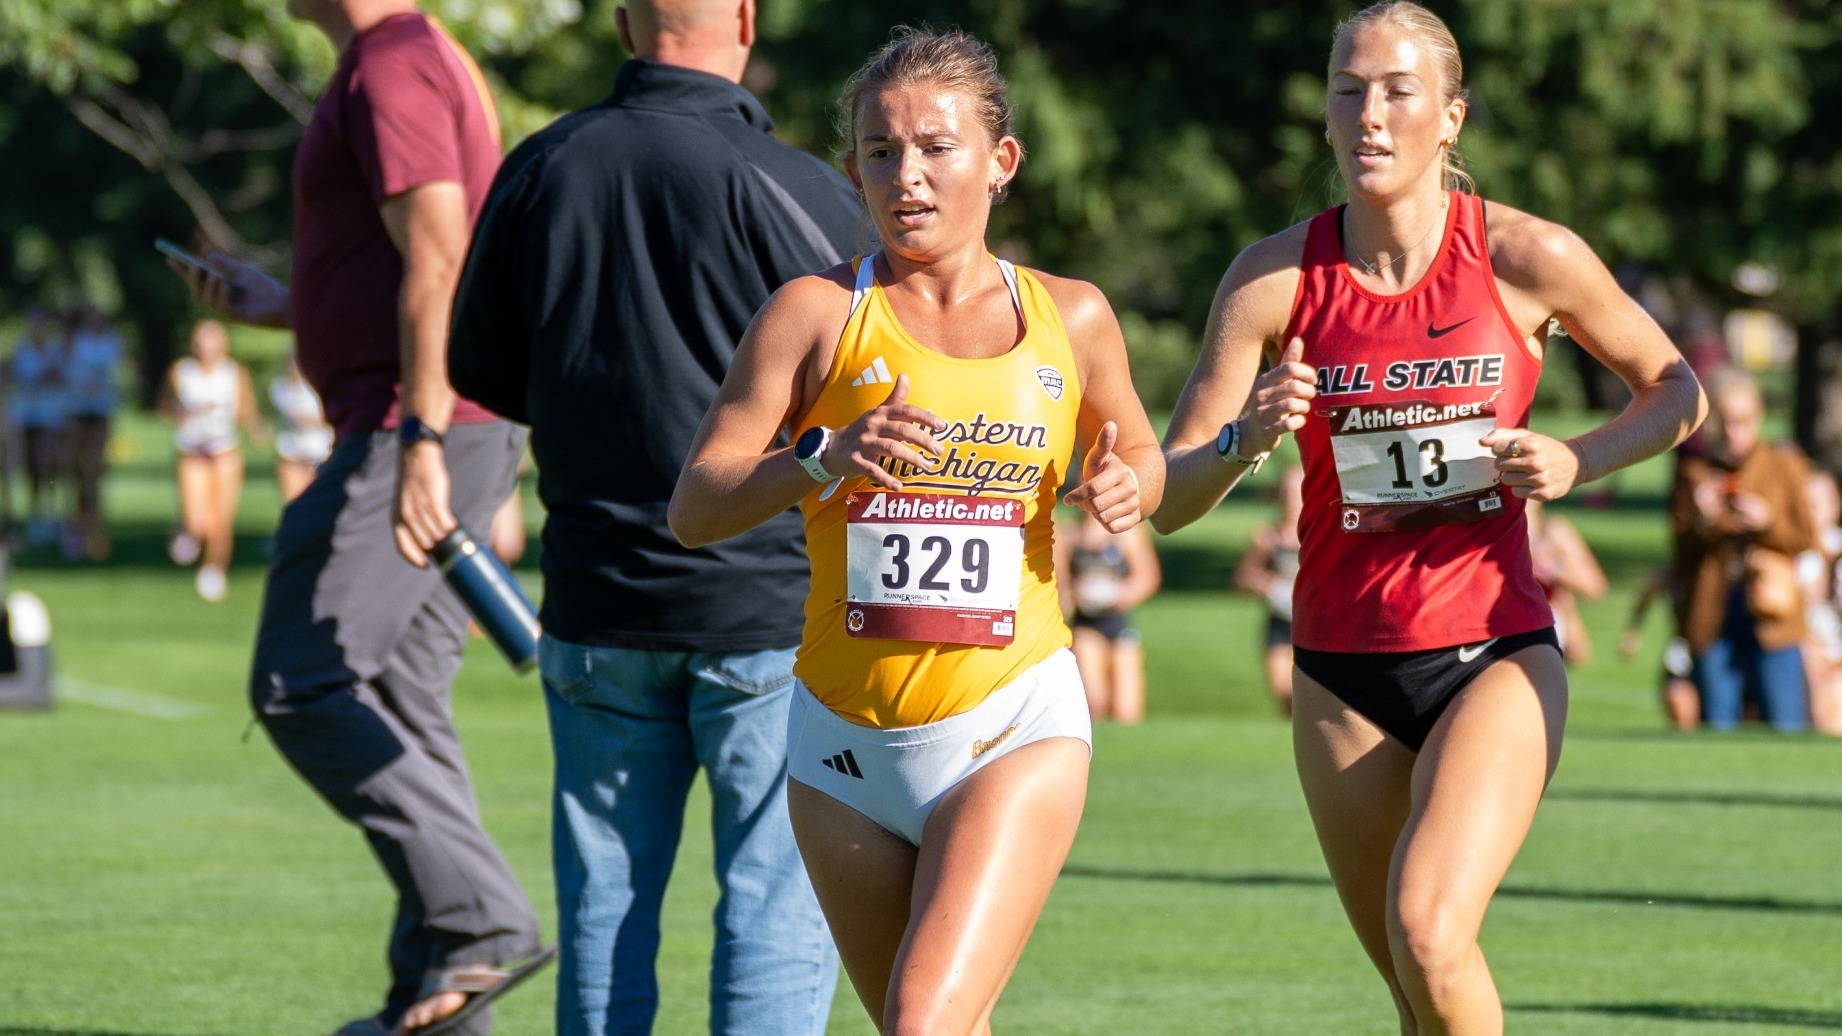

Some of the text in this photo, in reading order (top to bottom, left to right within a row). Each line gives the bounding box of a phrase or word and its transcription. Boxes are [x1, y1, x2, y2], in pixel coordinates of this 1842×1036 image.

[1316, 354, 1504, 395] ALL STATE
[918, 414, 1046, 449] estern
[1341, 402, 1482, 433] Athletic.net
[1387, 439, 1449, 490] 13
[861, 493, 1014, 522] Athletic.net
[881, 533, 990, 594] 329
[883, 593, 931, 602] RUNNERSPACE
